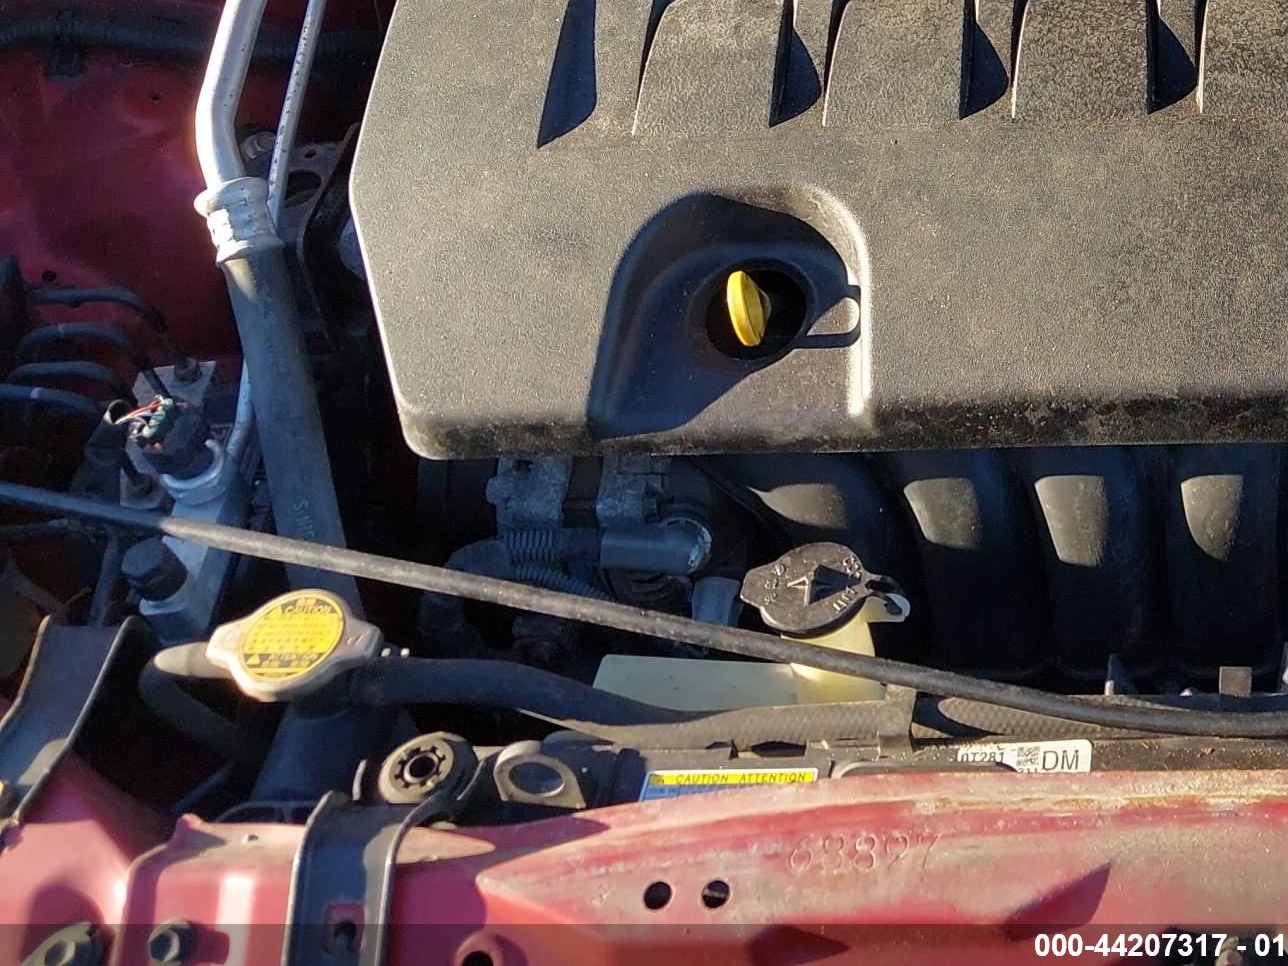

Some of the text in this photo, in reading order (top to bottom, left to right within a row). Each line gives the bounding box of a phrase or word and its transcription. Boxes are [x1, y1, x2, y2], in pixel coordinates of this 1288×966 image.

[1042, 750, 1079, 771] DM
[675, 772, 807, 784] CAUTION ATTENTION
